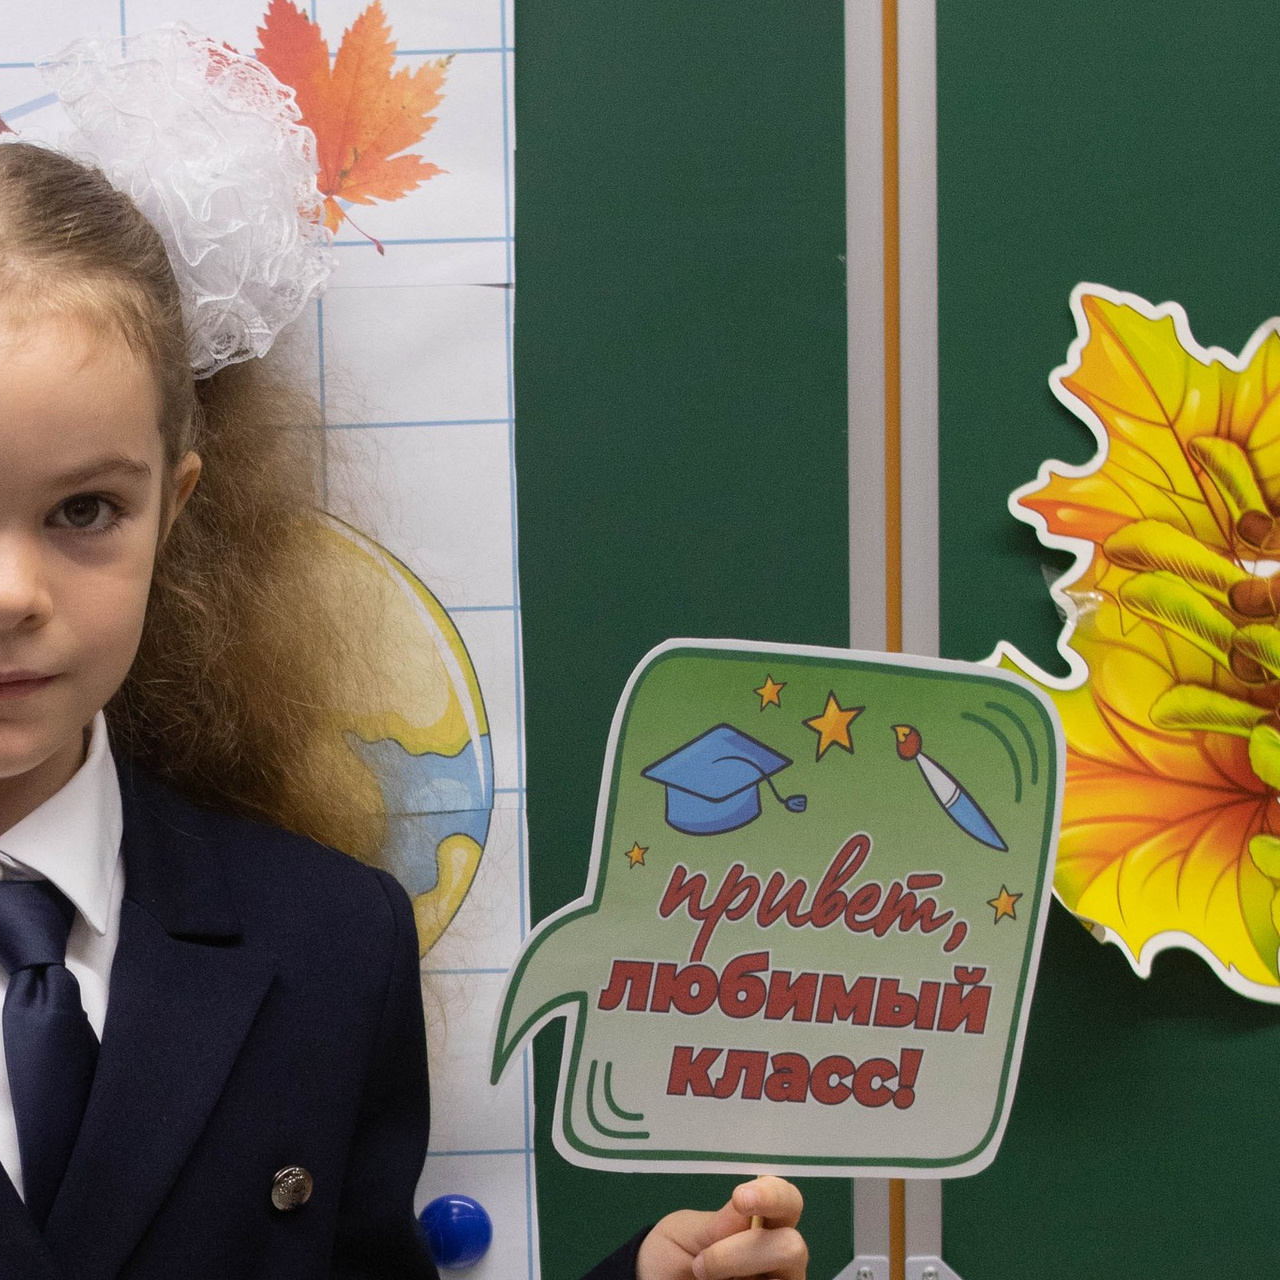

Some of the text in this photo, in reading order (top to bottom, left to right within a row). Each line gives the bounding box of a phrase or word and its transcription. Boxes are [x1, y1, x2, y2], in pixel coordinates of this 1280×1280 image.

[658, 834, 969, 962] привет,
[597, 952, 993, 1035] любимый
[666, 1046, 924, 1110] класс!
